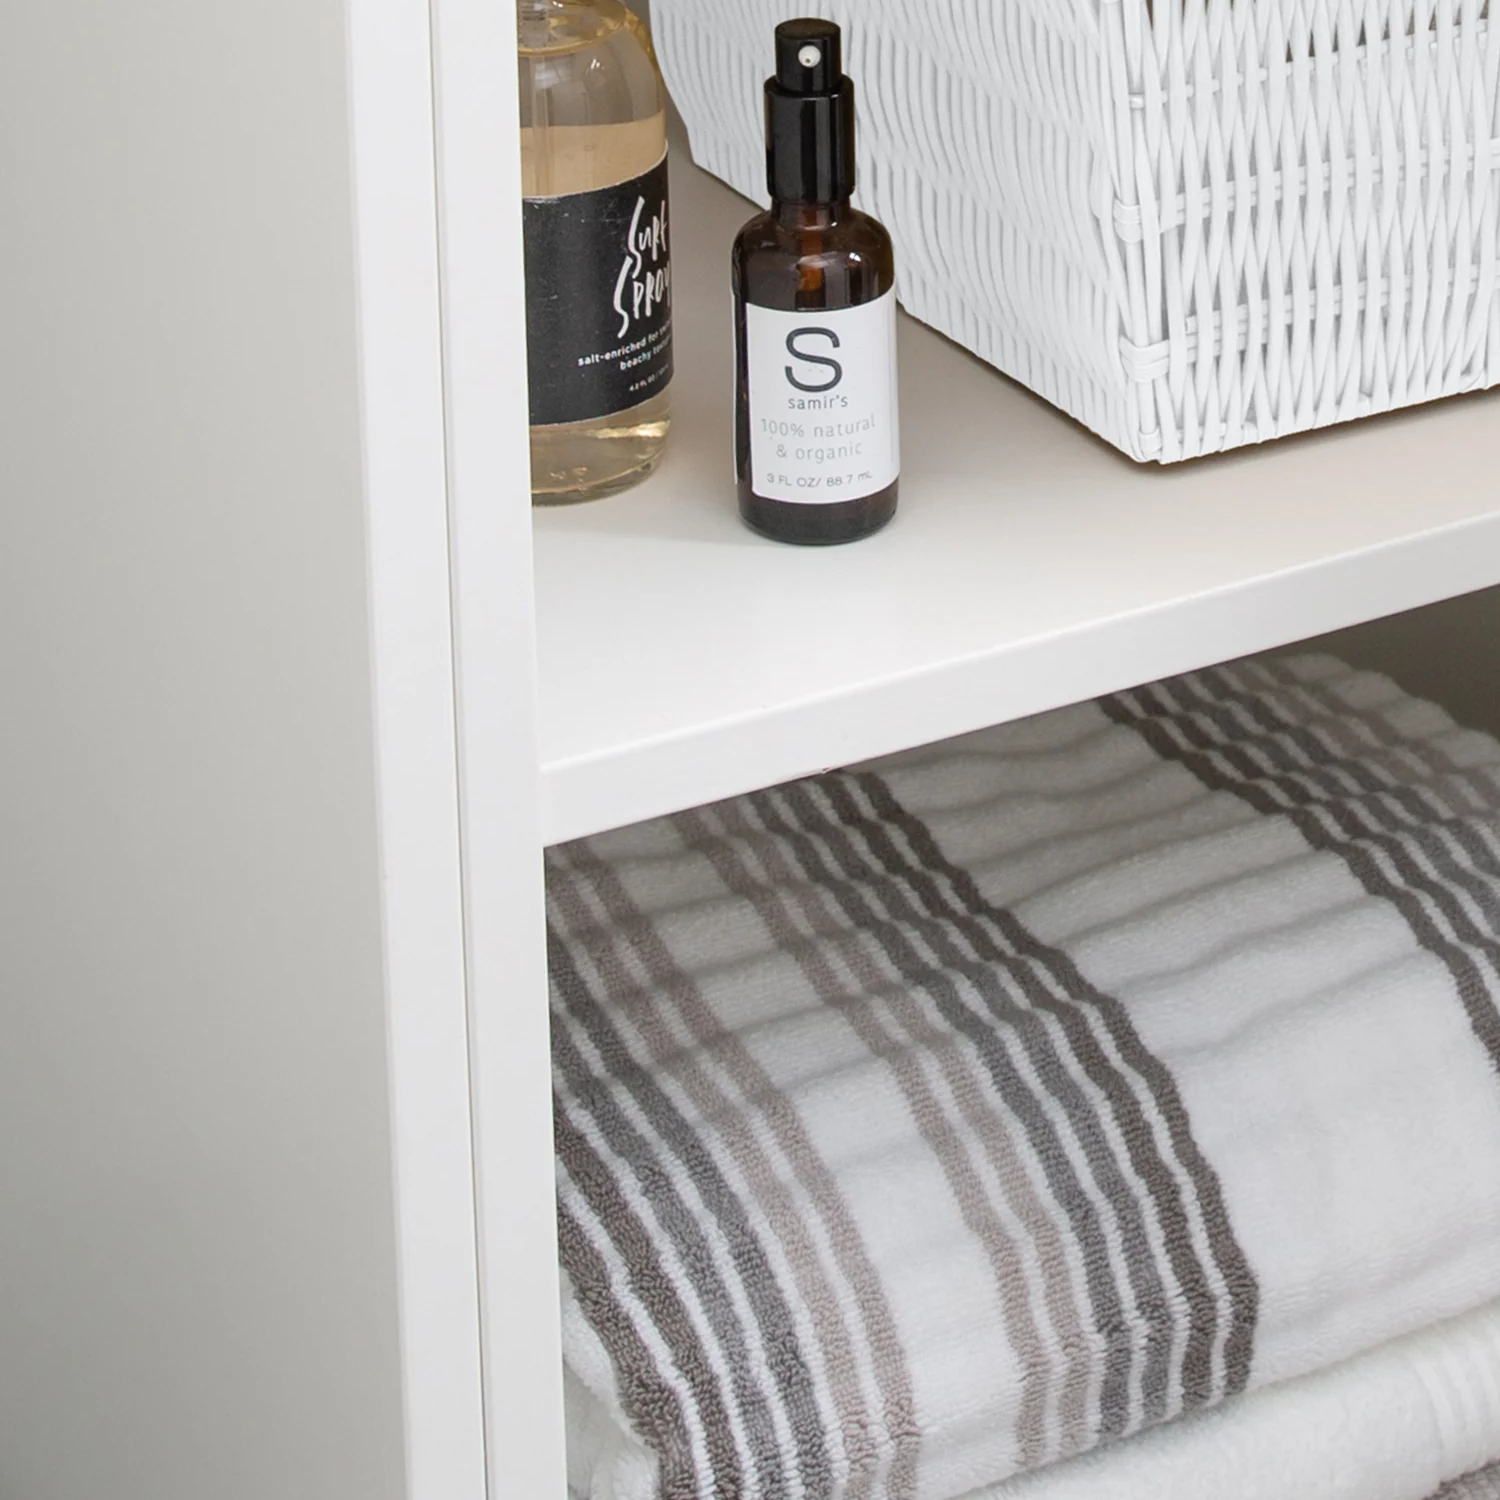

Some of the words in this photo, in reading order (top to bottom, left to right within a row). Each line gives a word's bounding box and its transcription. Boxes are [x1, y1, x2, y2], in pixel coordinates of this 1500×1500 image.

[577, 336, 647, 368] salt-enriched
[619, 350, 652, 371] beachy
[784, 326, 843, 393] S
[787, 394, 849, 411] samir's
[761, 417, 805, 438] 100%
[813, 412, 876, 438] natural
[775, 443, 788, 459] &
[795, 441, 863, 465] organic
[766, 472, 775, 484] 3
[777, 474, 793, 487] FL
